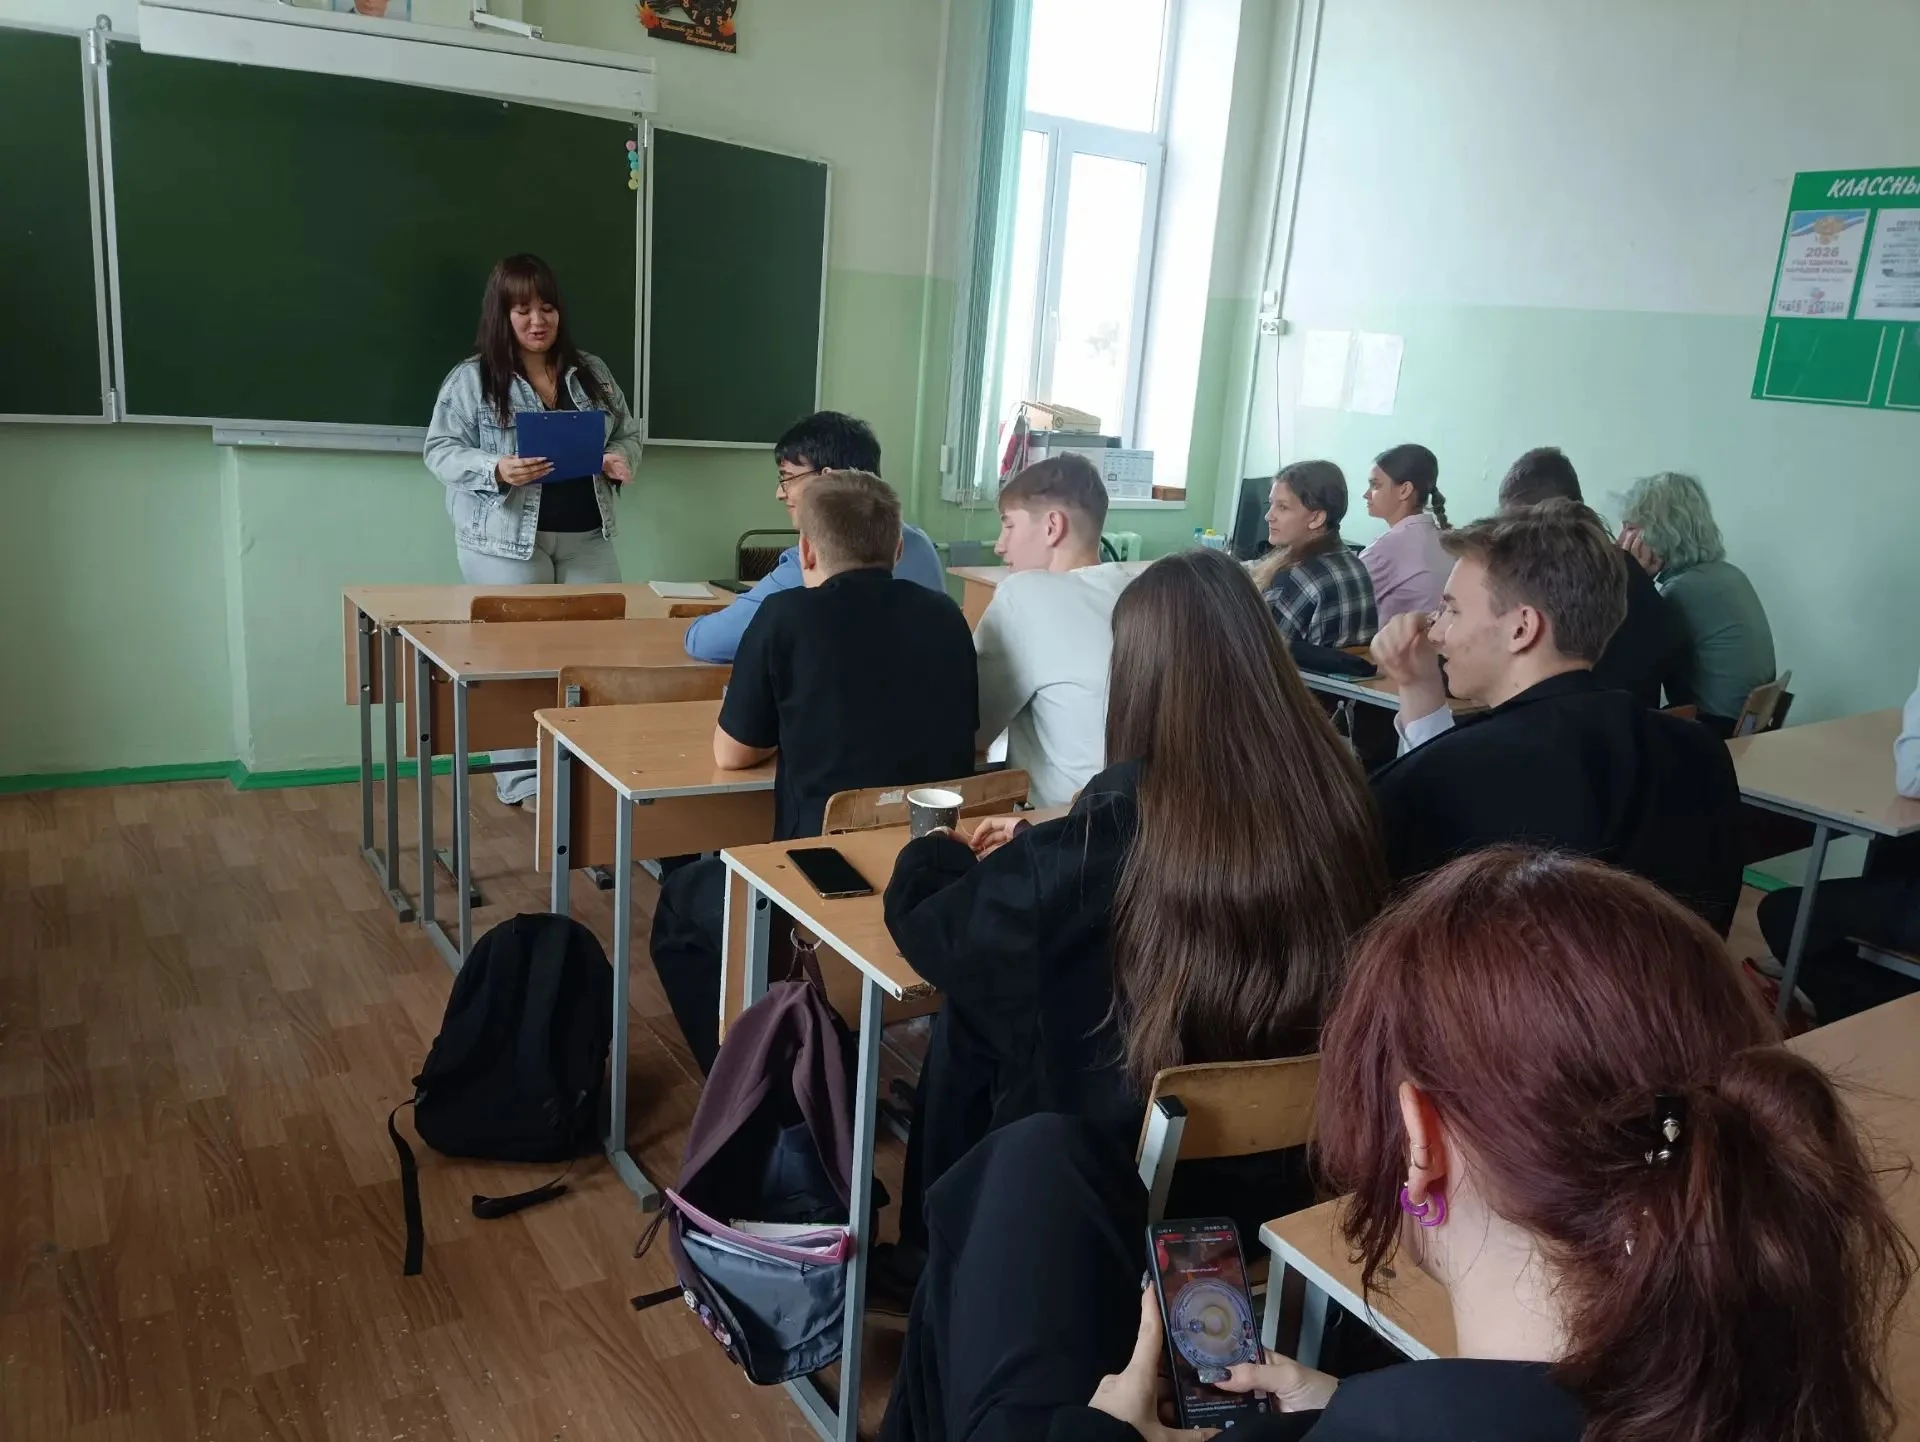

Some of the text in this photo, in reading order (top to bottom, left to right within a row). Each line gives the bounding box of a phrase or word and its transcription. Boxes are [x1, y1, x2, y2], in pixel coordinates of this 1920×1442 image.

[692, 10, 698, 19] 7
[704, 16, 711, 26] 6
[716, 15, 723, 25] 5
[1805, 246, 1840, 258] 2026
